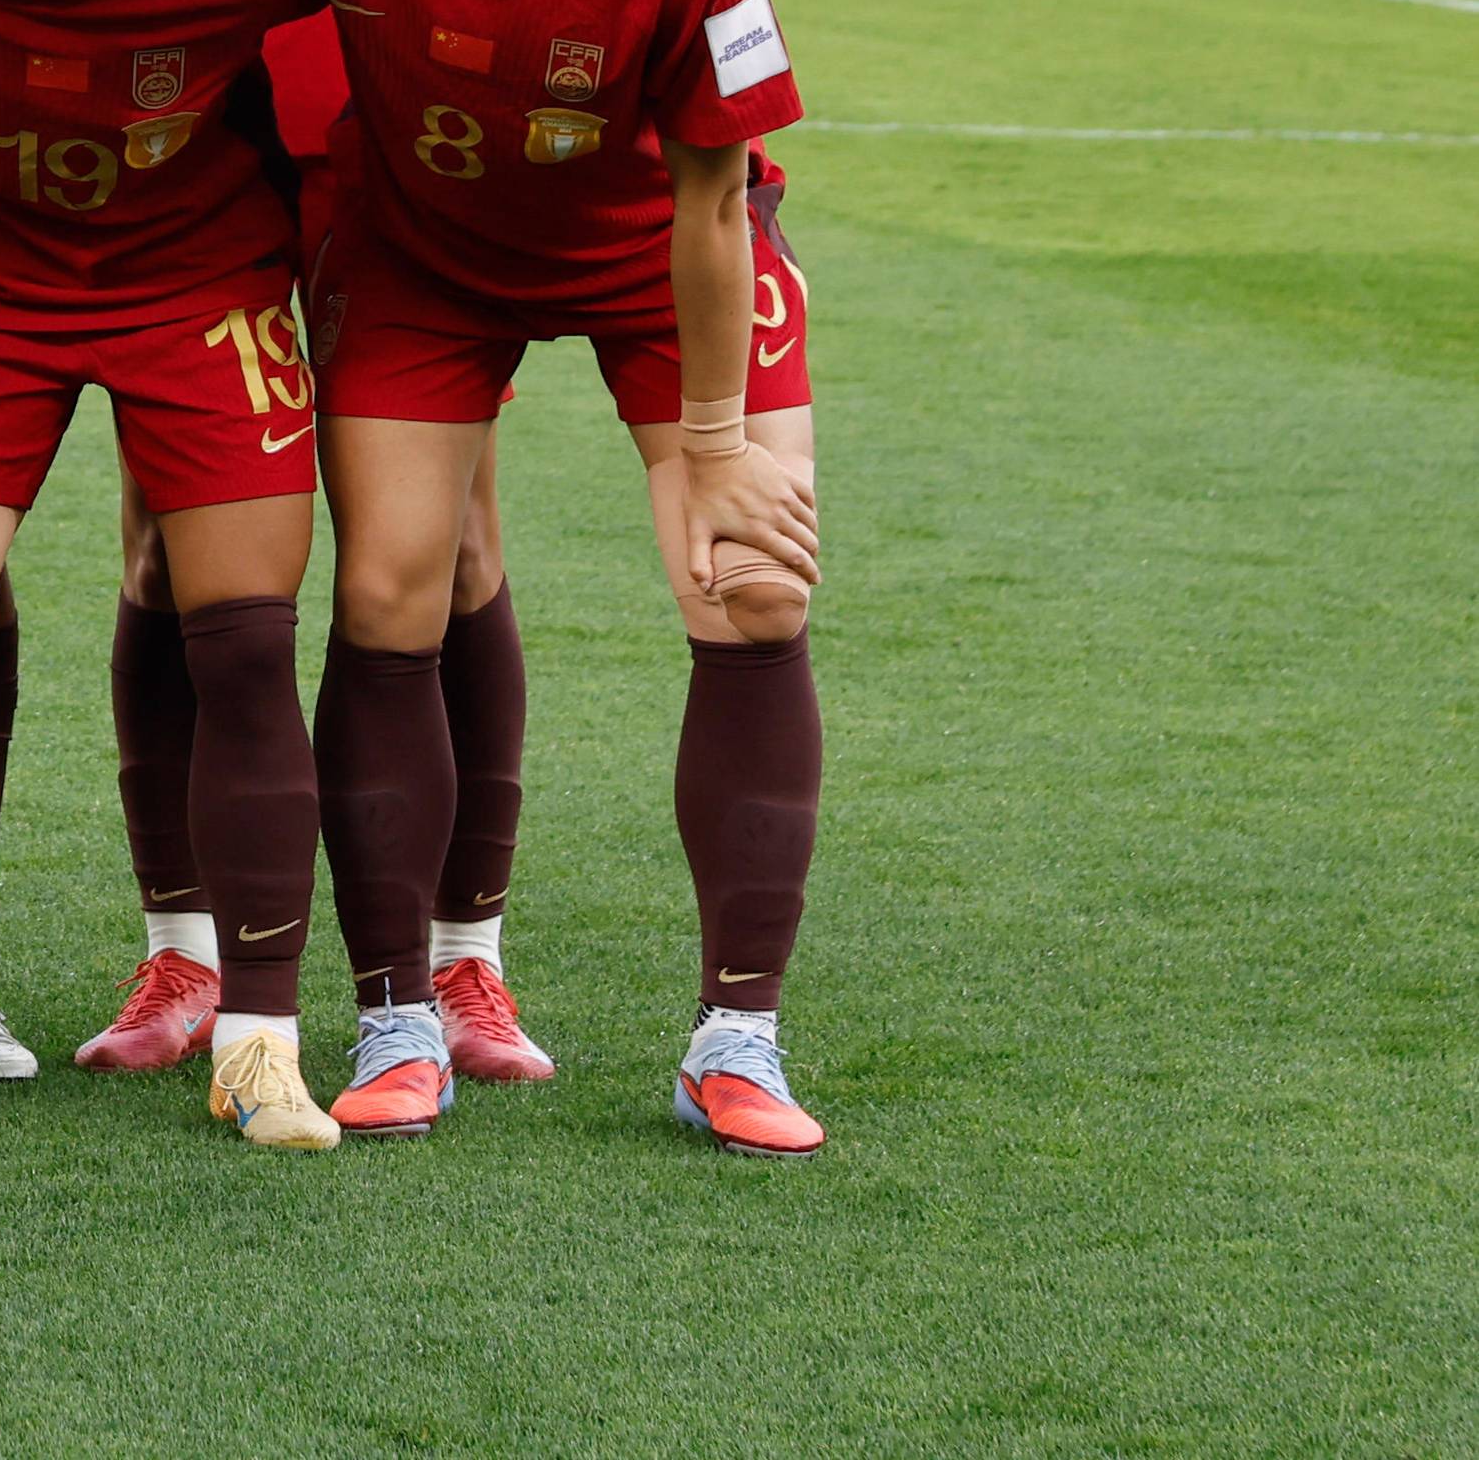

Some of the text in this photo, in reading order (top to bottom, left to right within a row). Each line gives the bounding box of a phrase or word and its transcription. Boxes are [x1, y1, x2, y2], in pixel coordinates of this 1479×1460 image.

[555, 43, 599, 62] CFA
[718, 30, 773, 66] FEARLESS
[724, 25, 764, 54] DREAM
[138, 51, 180, 65] CFA
[414, 104, 485, 180] 8
[204, 304, 311, 415] 19
